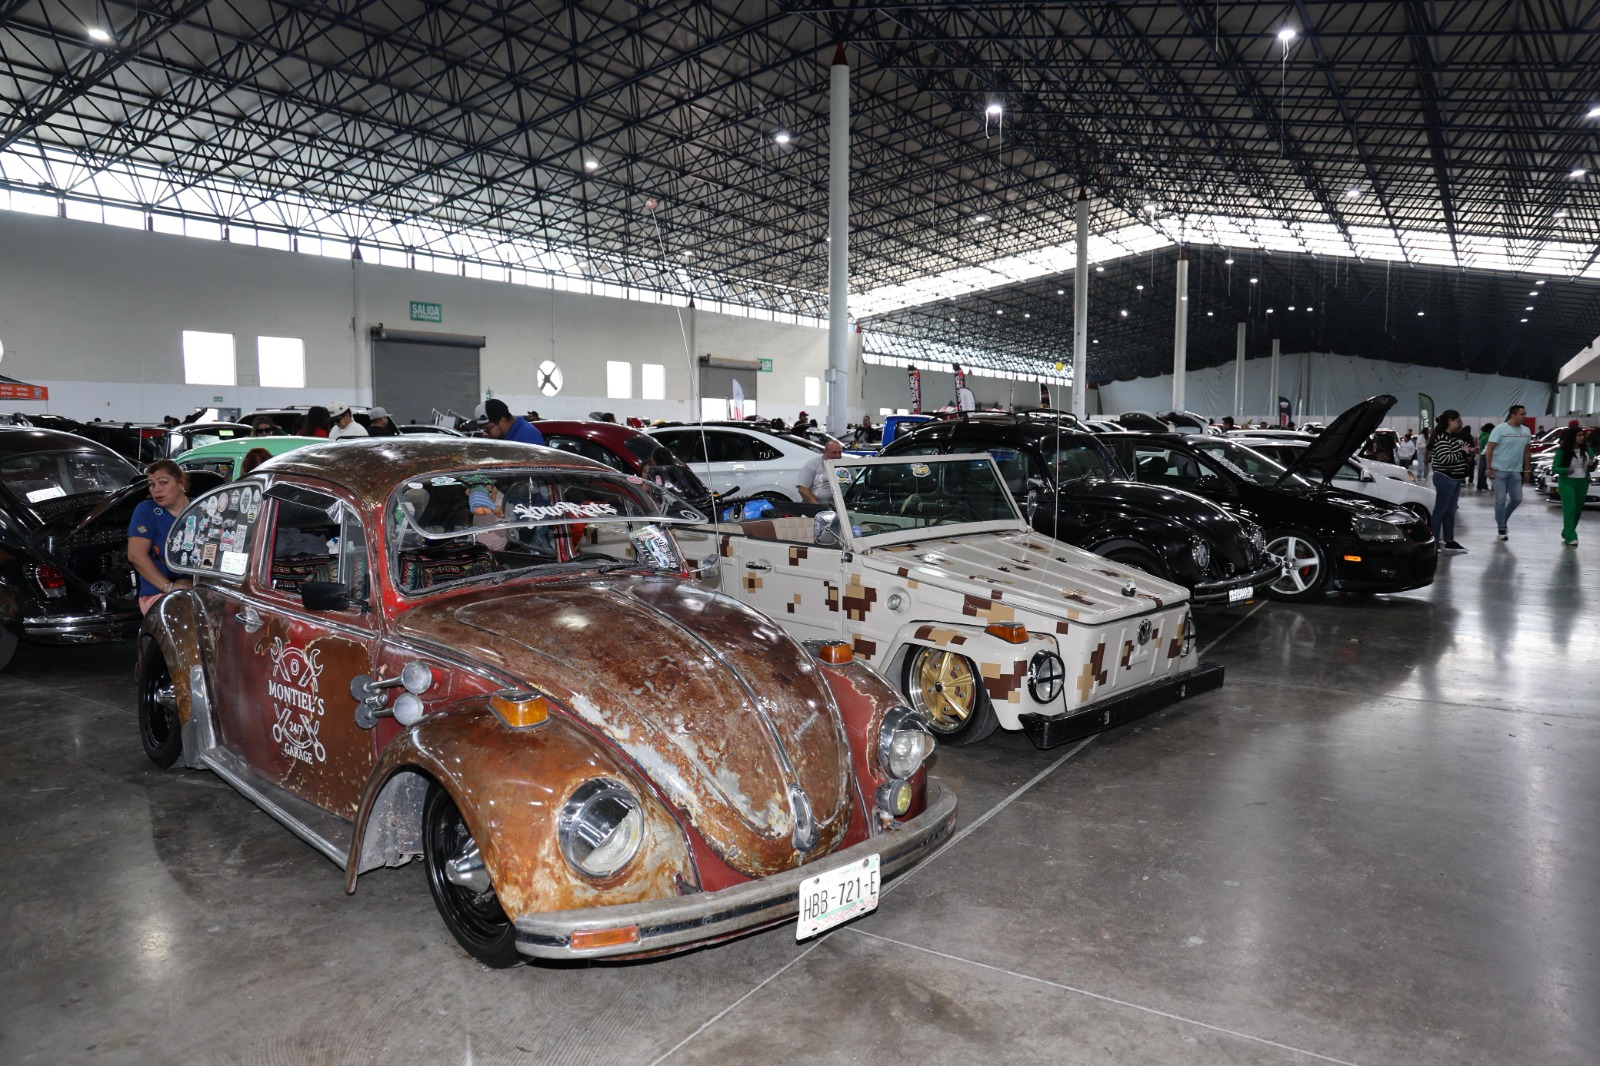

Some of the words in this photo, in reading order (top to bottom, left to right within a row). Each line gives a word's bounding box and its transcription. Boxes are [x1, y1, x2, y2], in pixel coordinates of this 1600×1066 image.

[412, 304, 439, 316] SALIDA
[268, 680, 324, 715] MONTIEL'S
[284, 743, 313, 764] GARAGE
[804, 871, 877, 922] HBB-721-E
